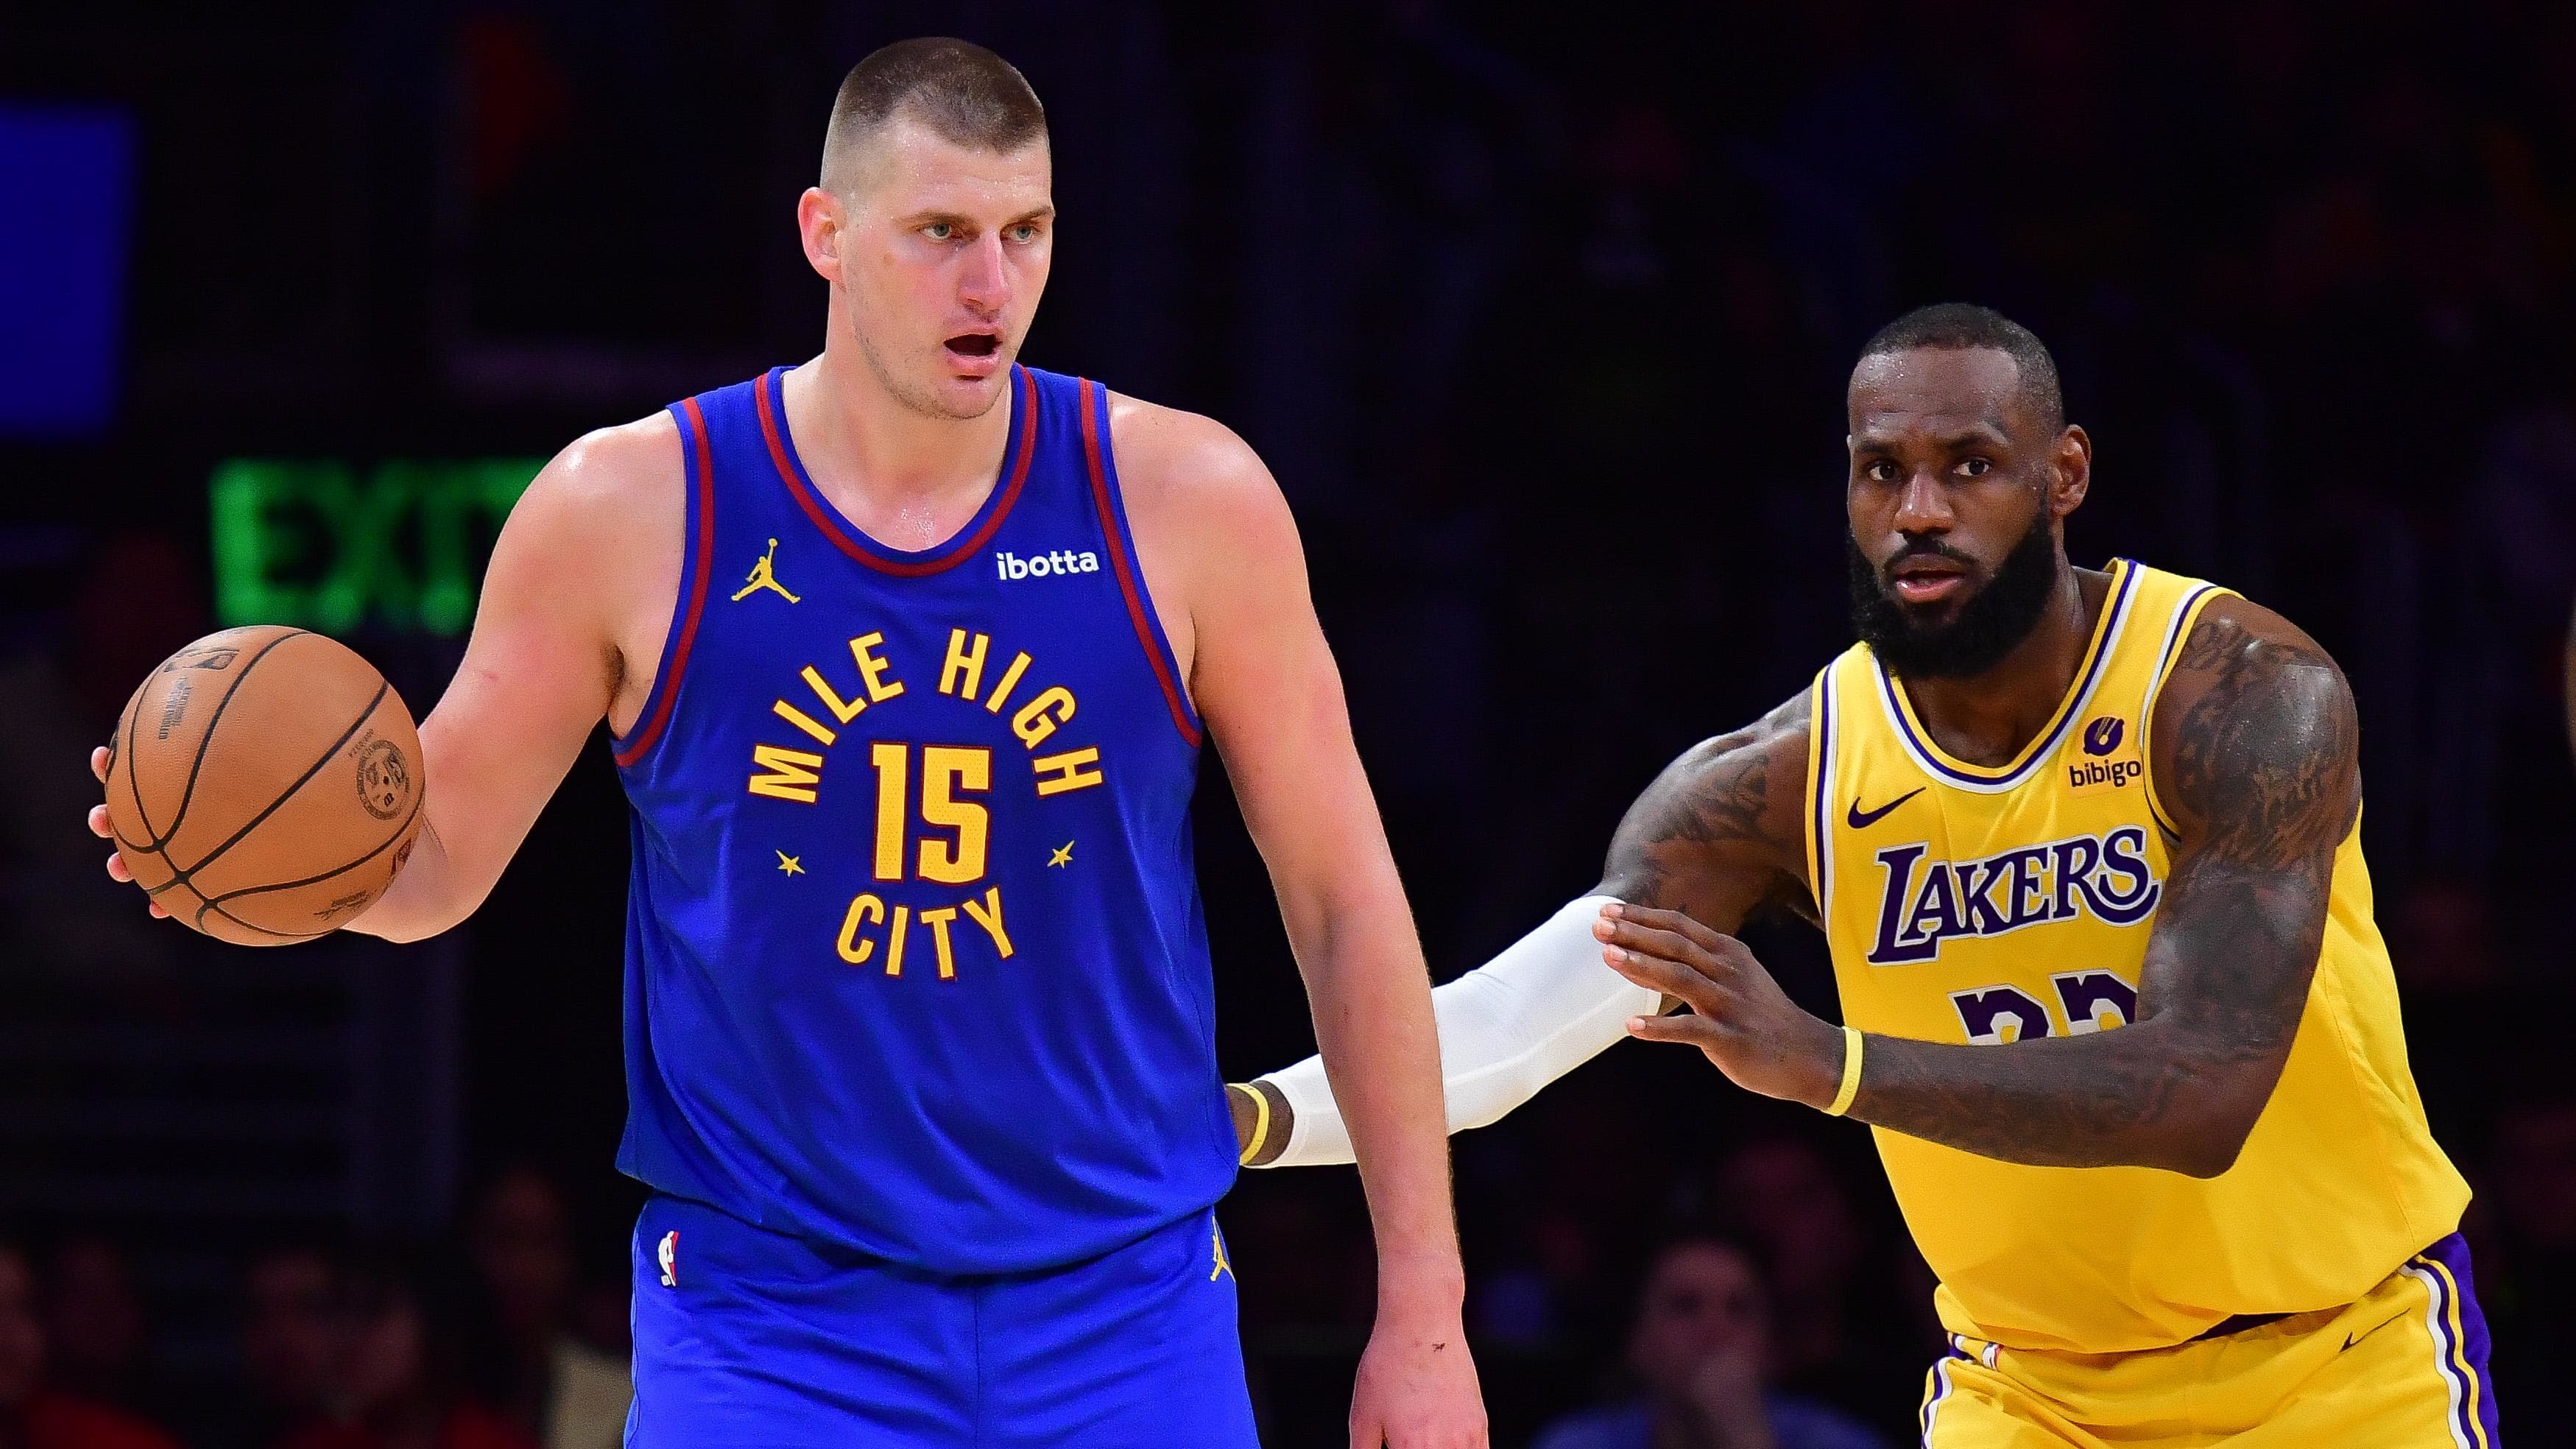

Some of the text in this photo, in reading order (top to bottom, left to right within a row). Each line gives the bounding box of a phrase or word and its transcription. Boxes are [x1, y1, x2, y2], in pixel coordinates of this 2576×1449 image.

[996, 550, 1099, 580] ibotta
[747, 627, 1104, 805] MILE HIGH
[2069, 758, 2142, 788] bibigo
[870, 741, 992, 884] 15
[835, 885, 1015, 980] CITY
[1867, 825, 2162, 966] LAKERS
